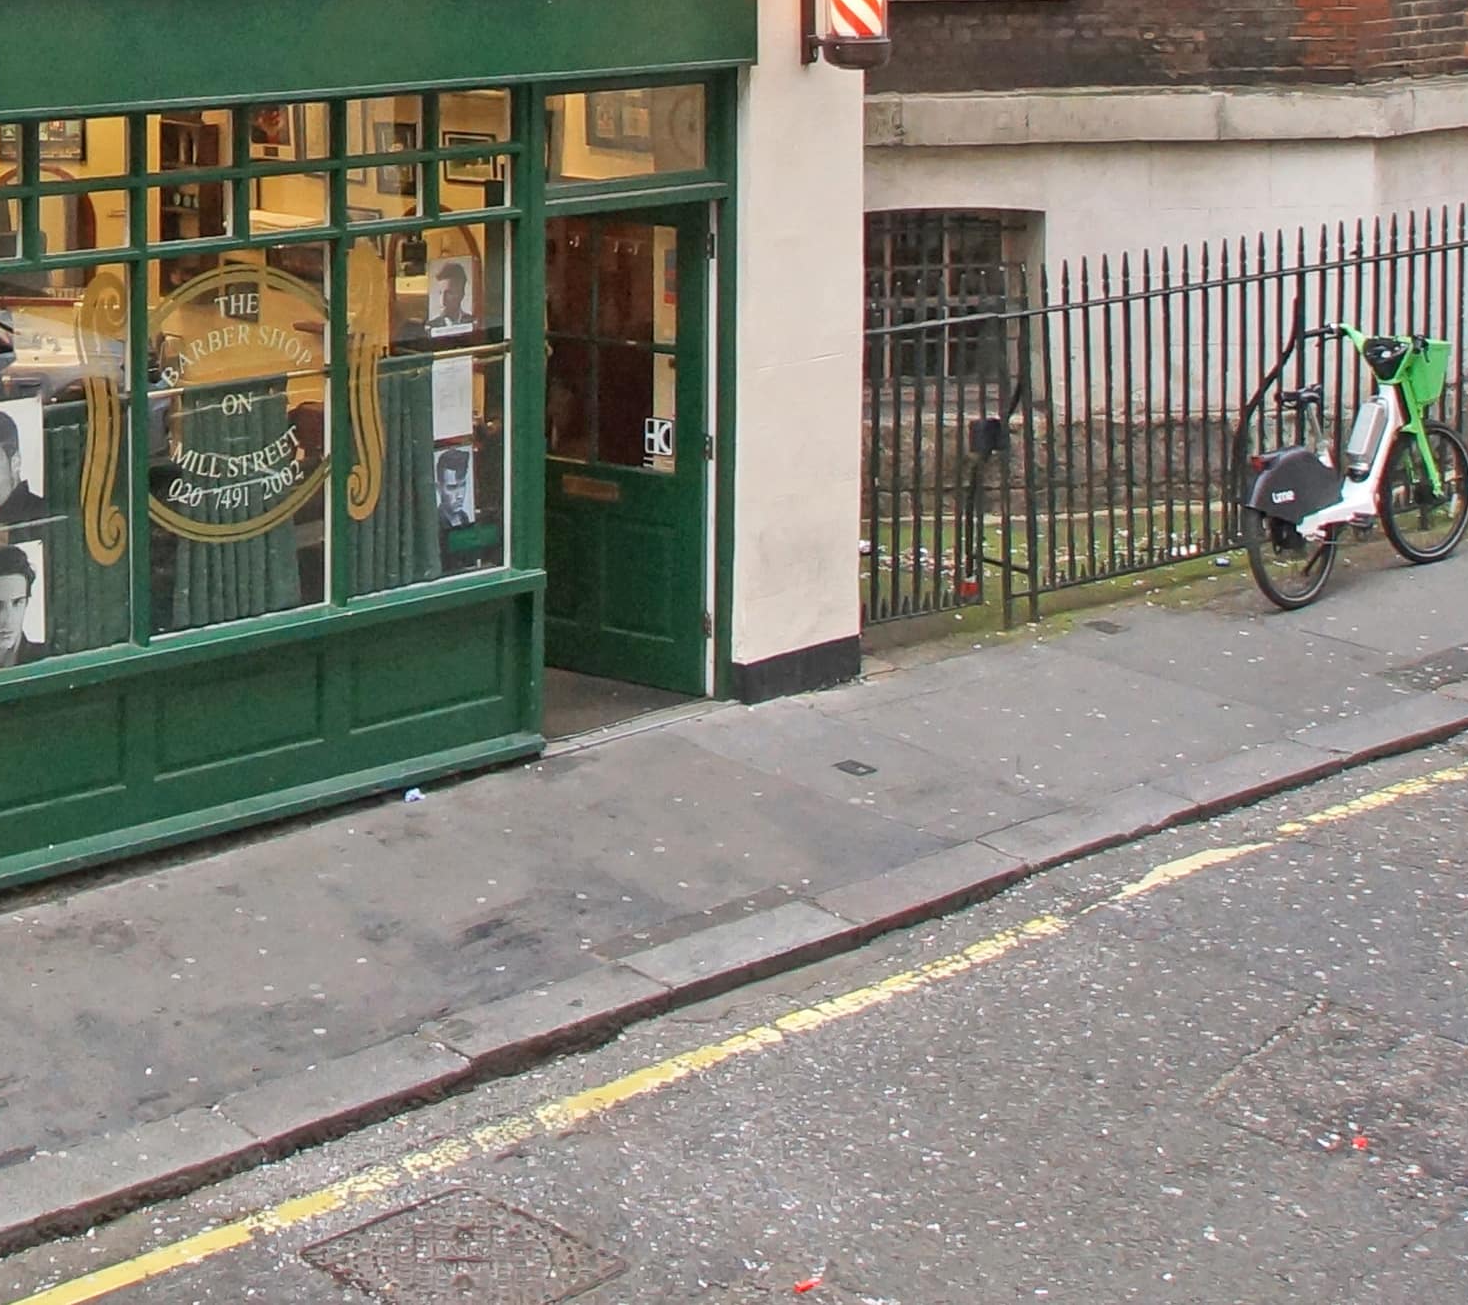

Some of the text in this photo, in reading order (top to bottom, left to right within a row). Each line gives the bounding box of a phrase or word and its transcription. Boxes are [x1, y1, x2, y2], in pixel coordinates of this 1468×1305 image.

[214, 293, 260, 319] THE
[161, 323, 313, 389] BARBER SHOP
[220, 392, 254, 416] ON
[169, 424, 301, 479] MILL STREET
[167, 458, 305, 511] 020 7491 2002
